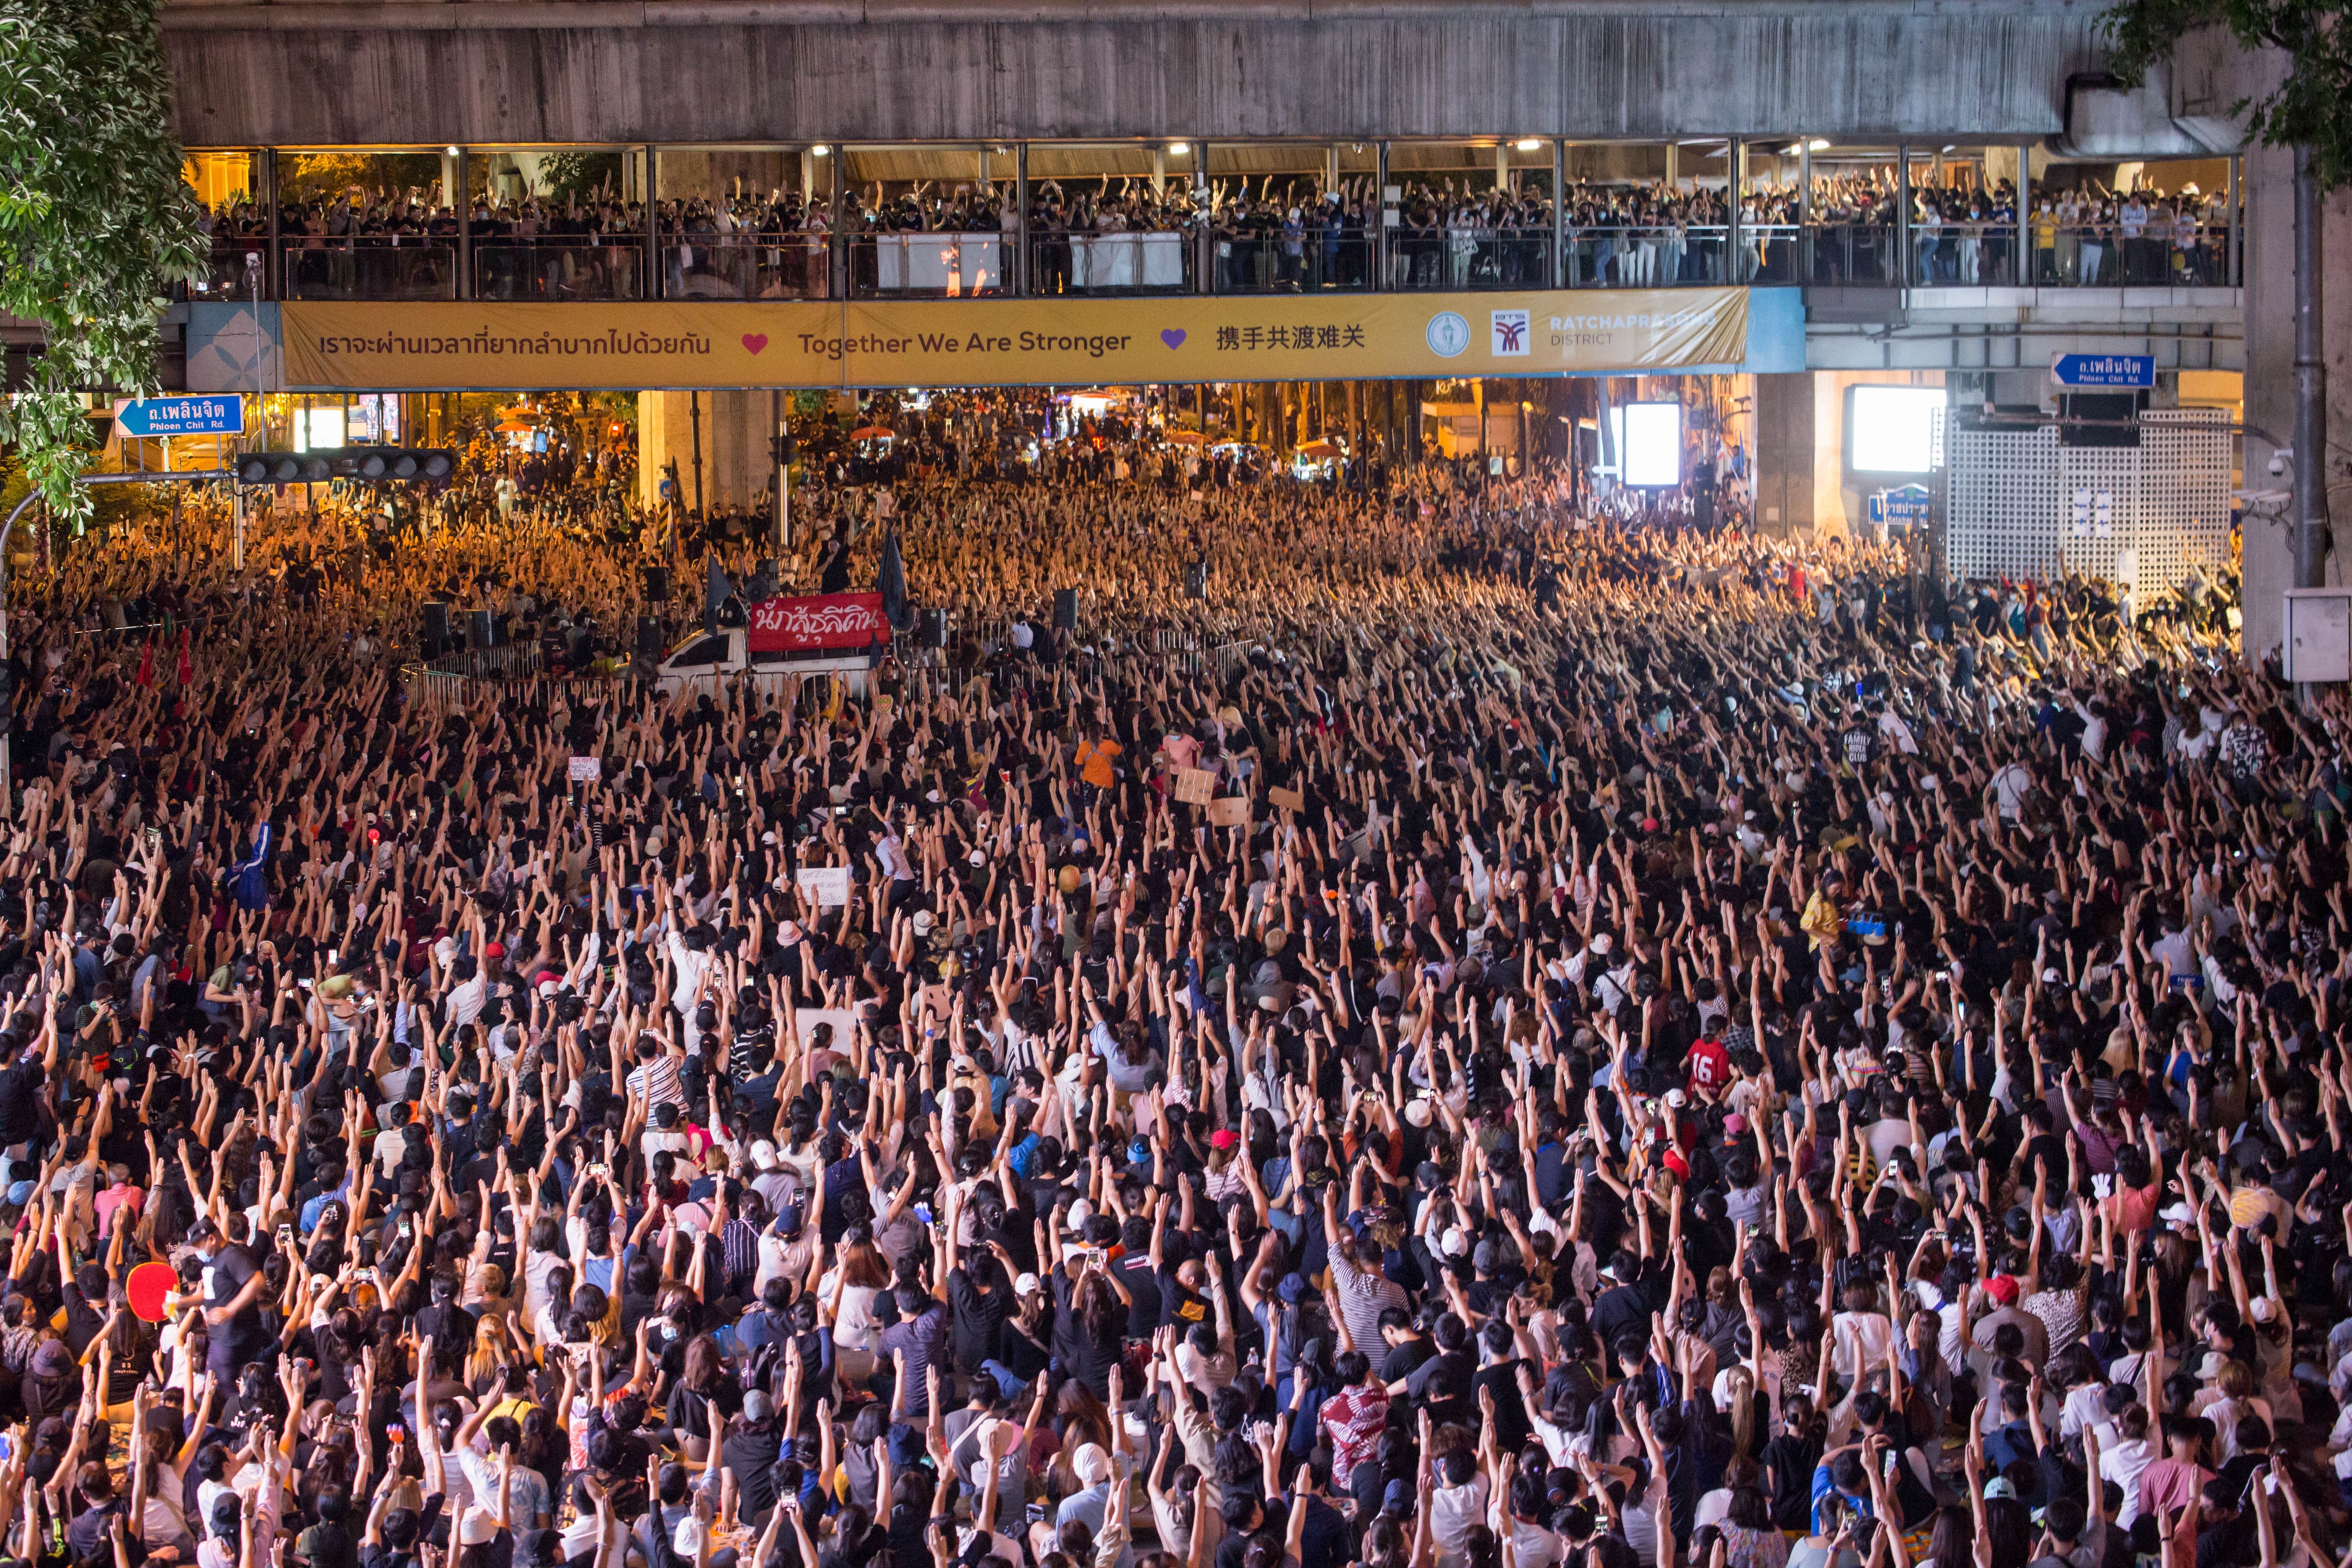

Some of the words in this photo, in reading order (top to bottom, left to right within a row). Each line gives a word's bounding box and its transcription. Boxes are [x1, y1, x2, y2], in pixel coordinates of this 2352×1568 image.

[320, 325, 710, 354] เราจะผ่านเวลาที่ยากลำบากไปด้วยกัน
[798, 334, 913, 361] Together
[918, 333, 960, 353] We
[966, 332, 1012, 352] Are
[1019, 331, 1131, 358] Stronger
[1216, 324, 1365, 351] 携手共渡难关
[1551, 333, 1613, 347] DISTRICT
[2080, 357, 2140, 374] ถ.เพลินจิต
[2079, 374, 2104, 383] Phloen
[2109, 375, 2123, 383] Chit
[2128, 375, 2140, 383] Rd.
[149, 400, 225, 420] ถ.เพลินจิต
[149, 423, 180, 431] Phloen
[186, 421, 204, 429] Chit
[756, 600, 879, 644] นักสู้ธุลีดิน
[1844, 731, 1871, 746] FAMILY
[1849, 752, 1867, 762] CLUB
[1693, 1052, 1713, 1084] 16
